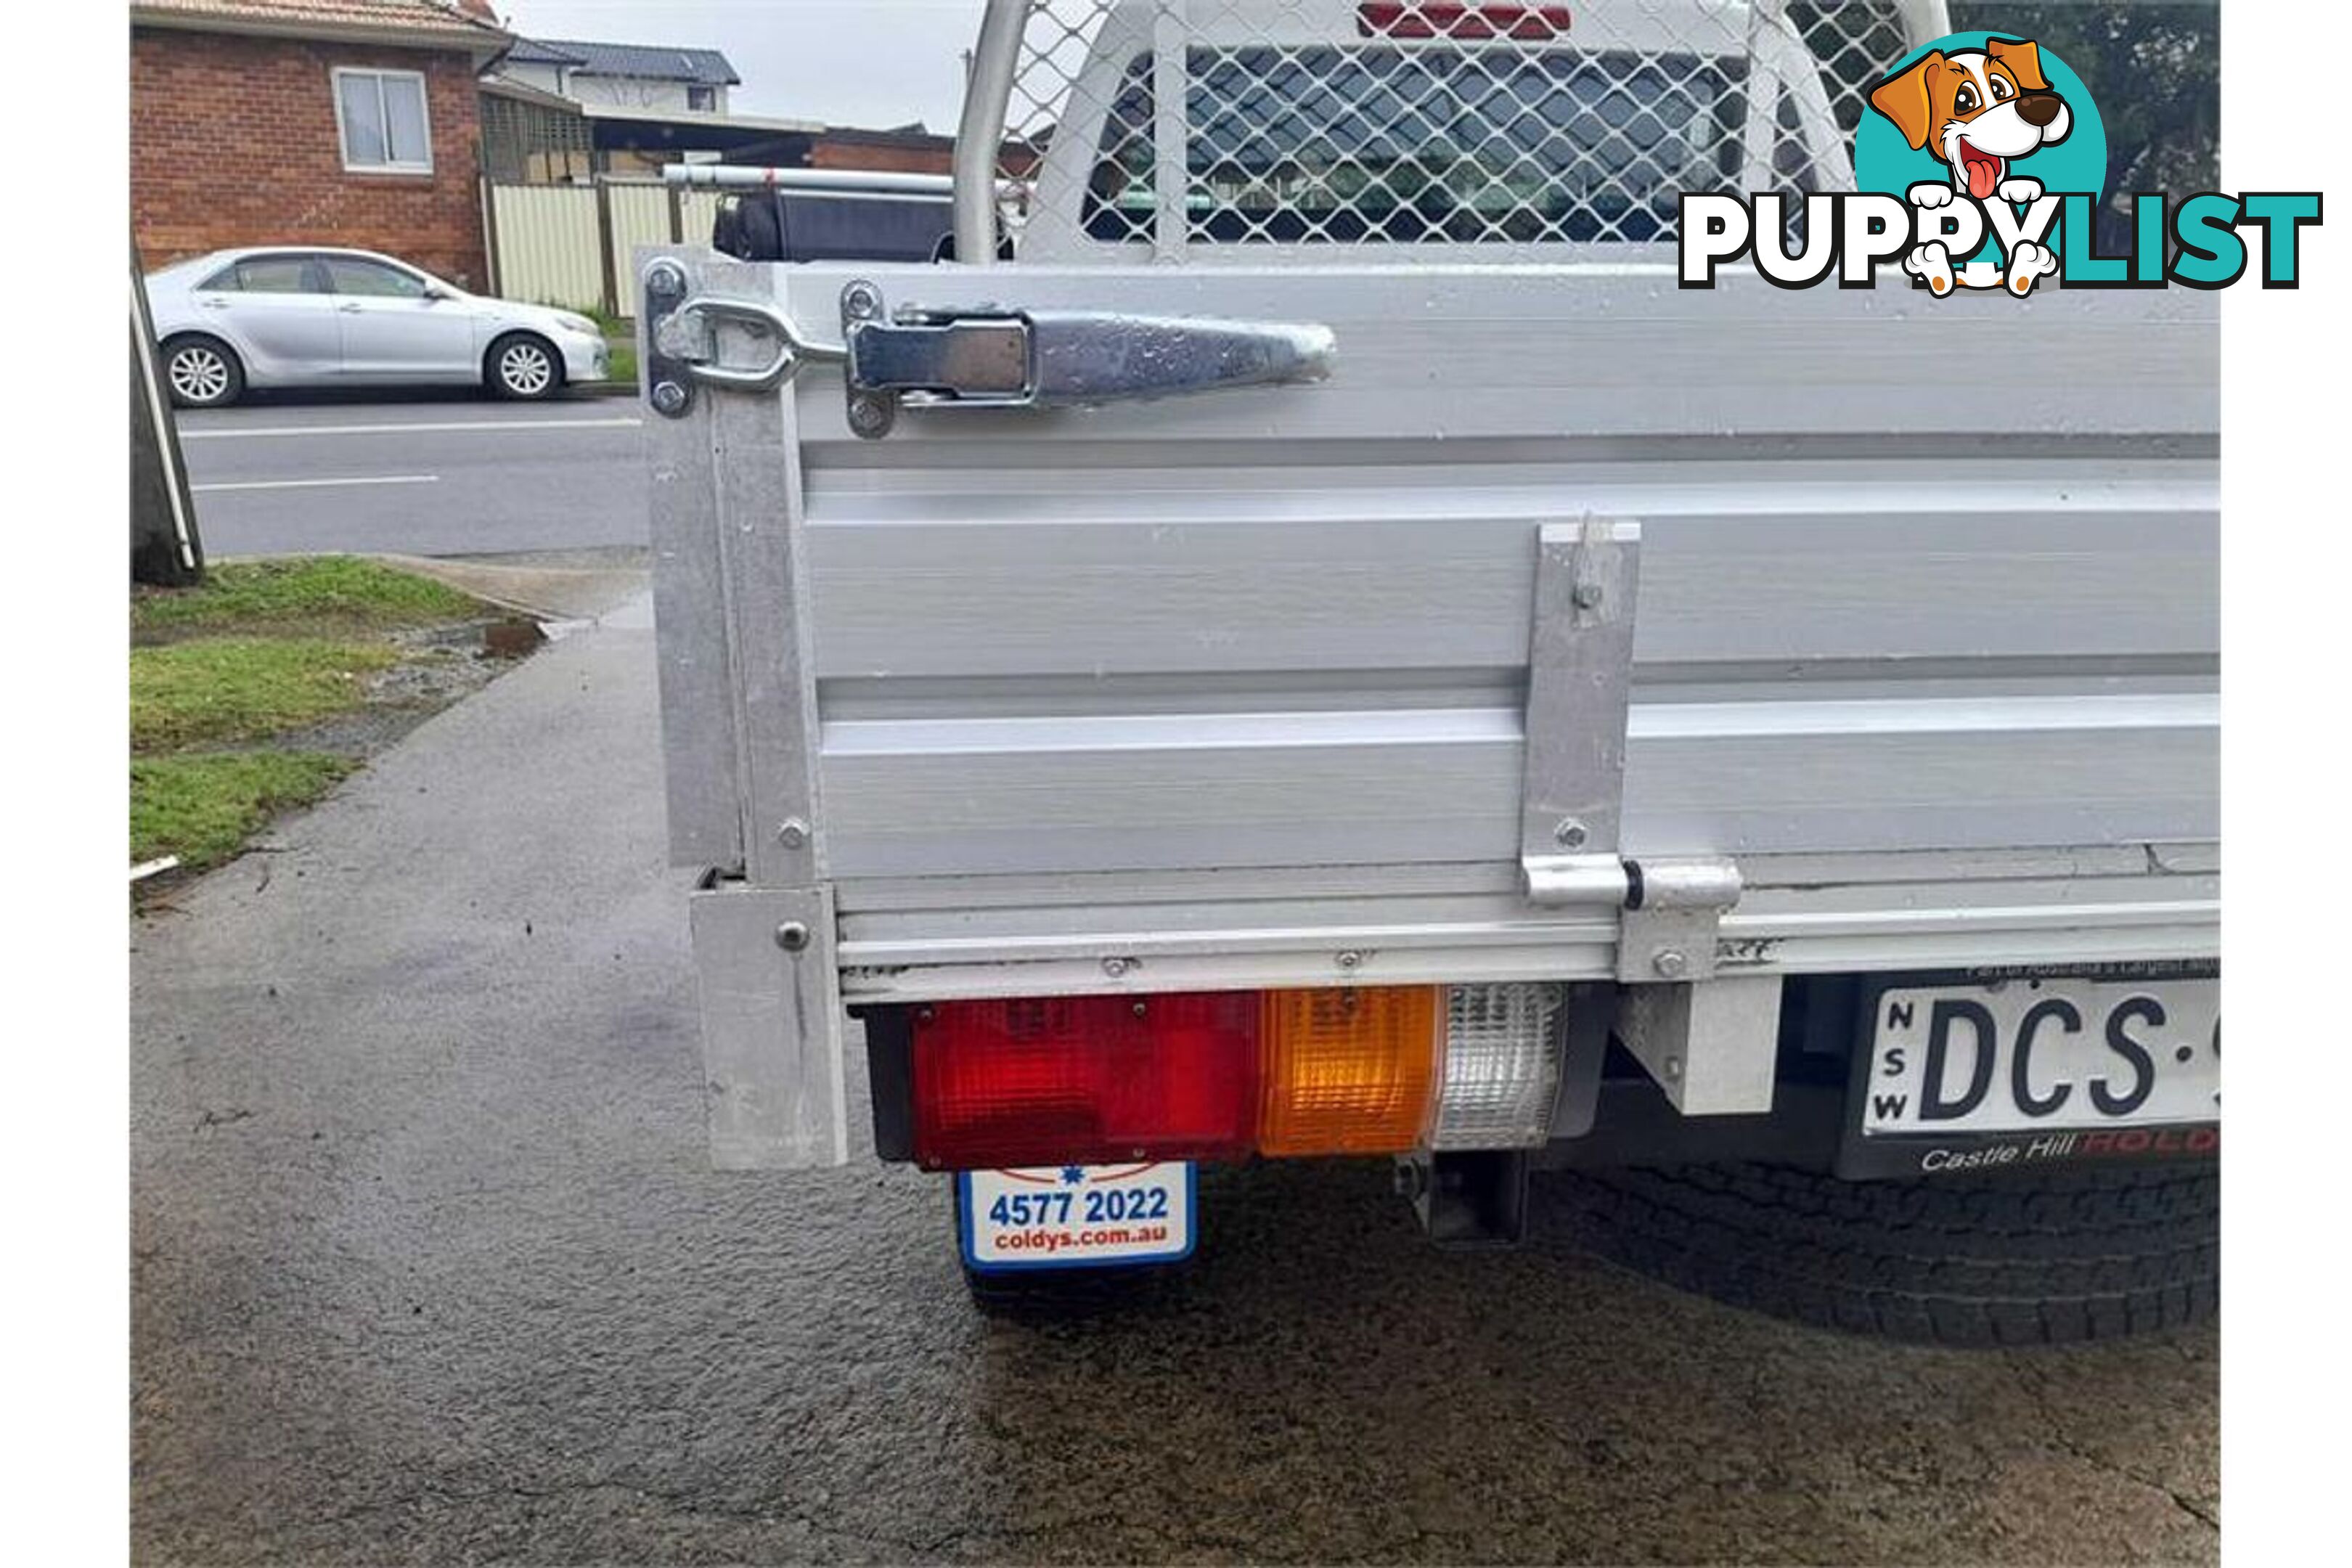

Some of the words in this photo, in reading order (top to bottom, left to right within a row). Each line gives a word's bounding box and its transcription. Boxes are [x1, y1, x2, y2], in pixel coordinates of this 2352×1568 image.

[1874, 1001, 1914, 1120] NSW
[1921, 1147, 2019, 1172] Castle
[2025, 1133, 2076, 1158] Hill
[989, 1192, 1073, 1227] 4577
[1085, 1187, 1169, 1221] 2022
[995, 1225, 1168, 1251] coldys.com.au
